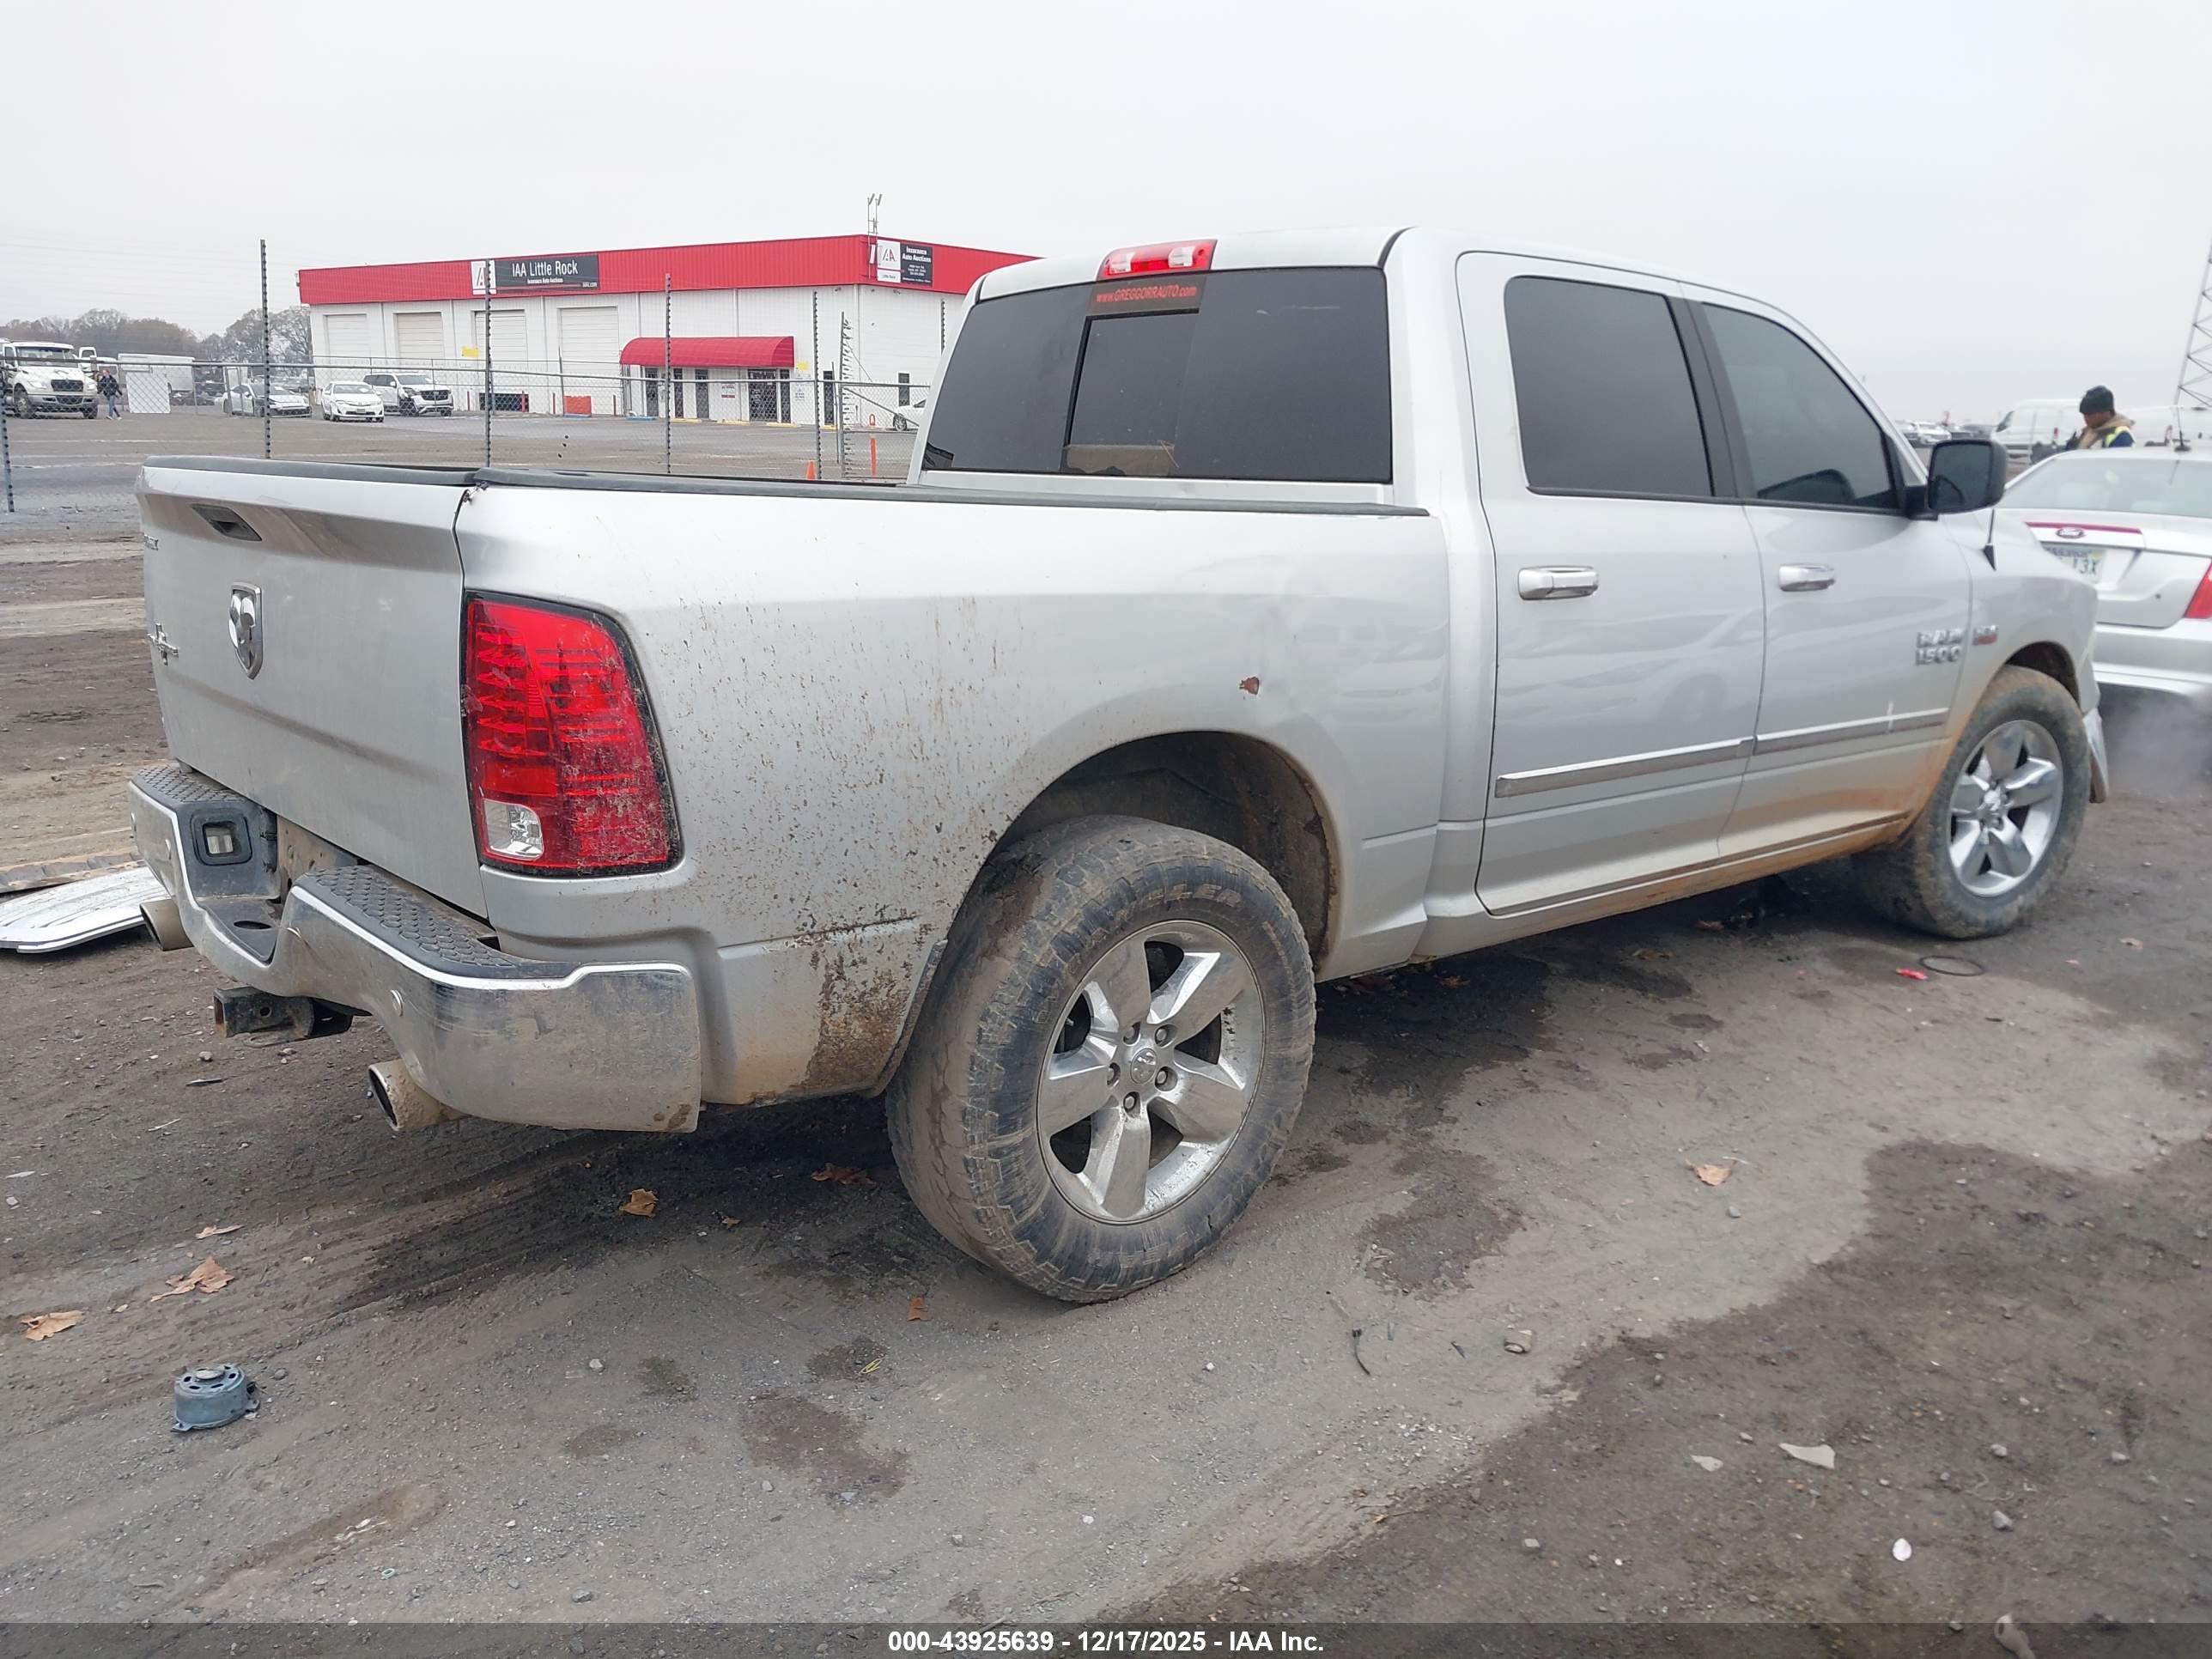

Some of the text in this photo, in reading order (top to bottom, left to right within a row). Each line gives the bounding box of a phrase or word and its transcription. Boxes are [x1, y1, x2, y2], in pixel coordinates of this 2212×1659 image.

[512, 259, 579, 277] IAA Little Rock
[1915, 647, 1961, 666] 1500
